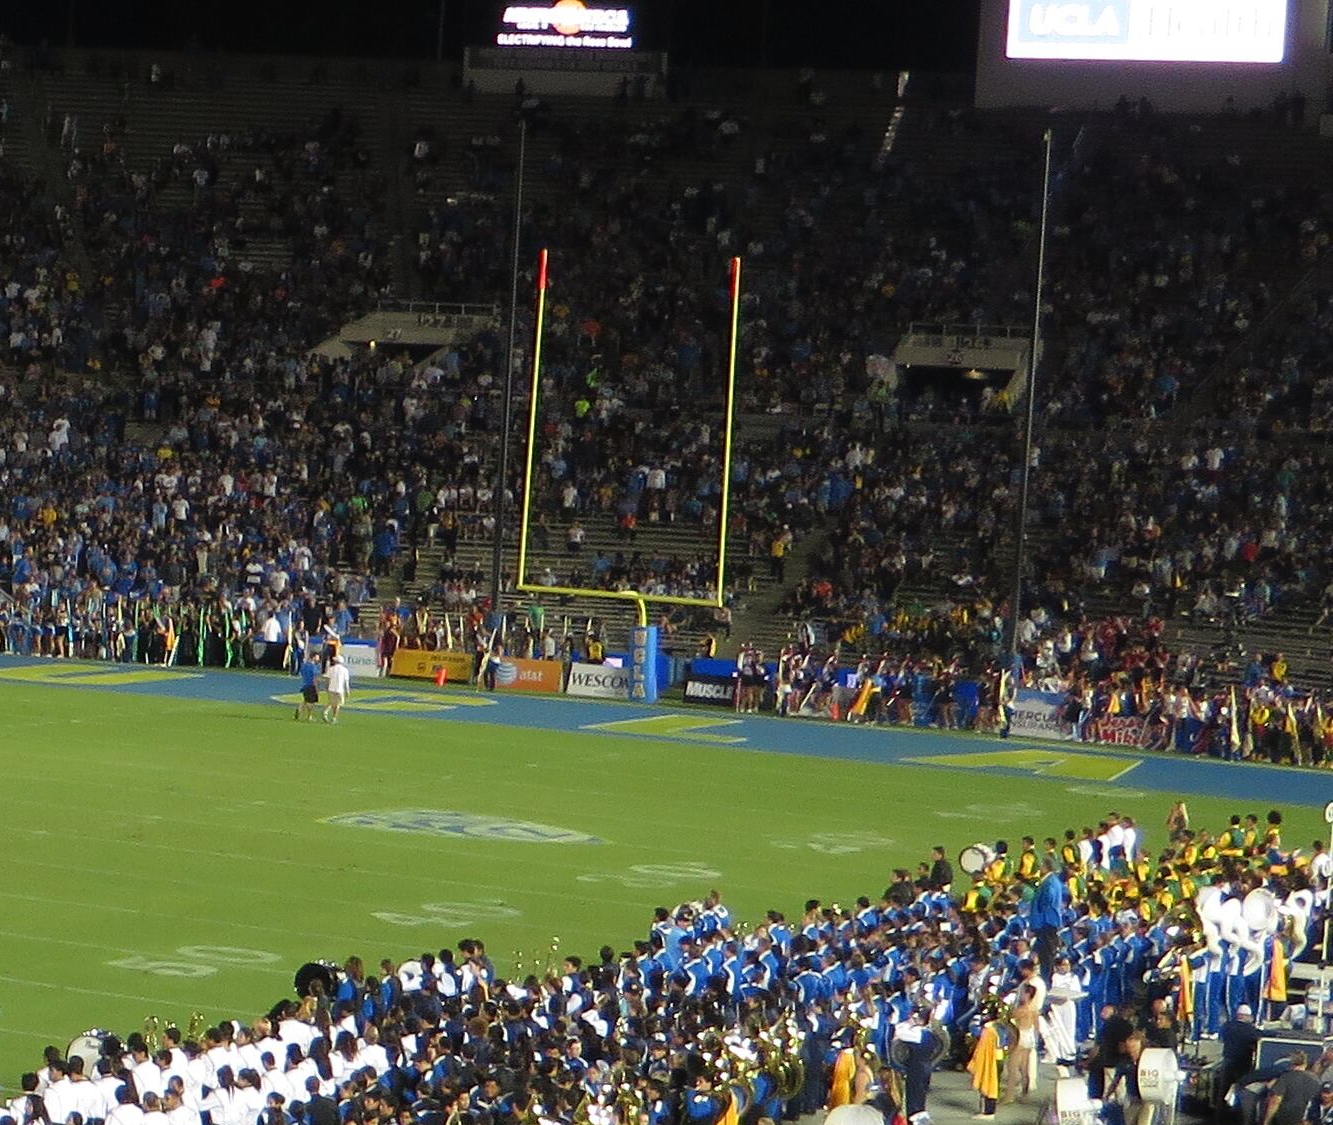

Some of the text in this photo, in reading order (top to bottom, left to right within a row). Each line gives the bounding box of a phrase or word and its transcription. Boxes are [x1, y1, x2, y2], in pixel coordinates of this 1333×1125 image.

[1029, 4, 1119, 37] UCLA
[631, 629, 648, 699] UCLA
[686, 681, 733, 700] MUSCLE
[104, 943, 283, 979] 50
